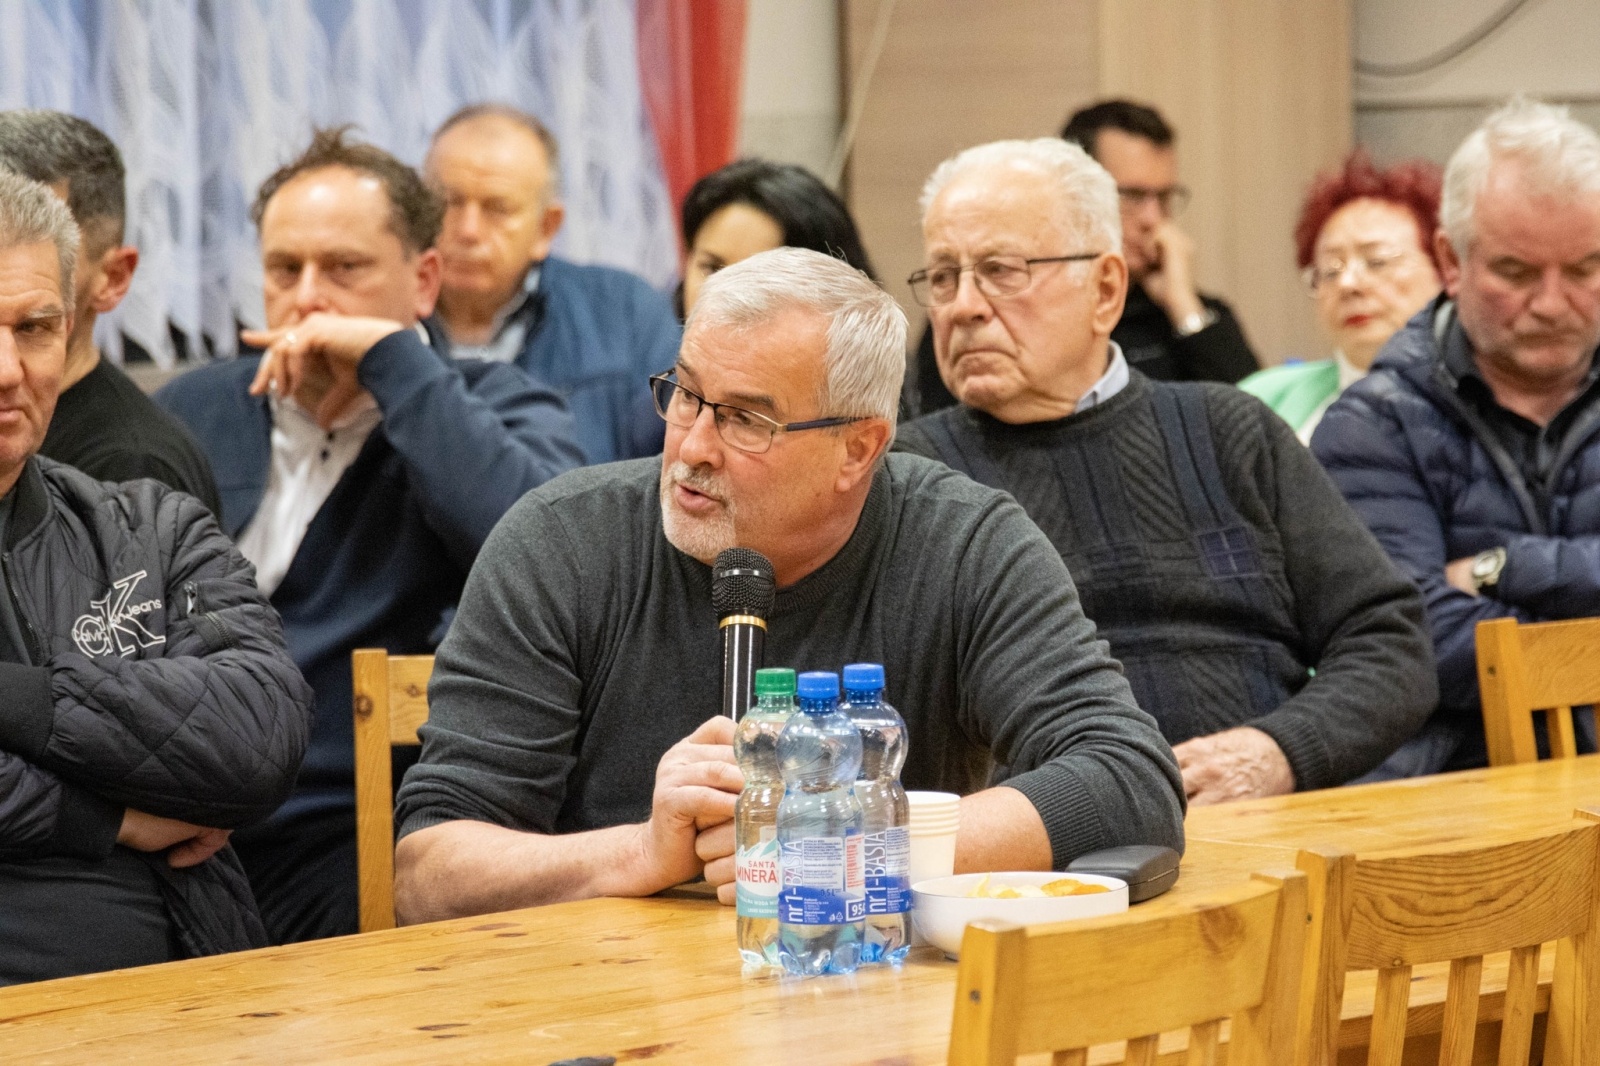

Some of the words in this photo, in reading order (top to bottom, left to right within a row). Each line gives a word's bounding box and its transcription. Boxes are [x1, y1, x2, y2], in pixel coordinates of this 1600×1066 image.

[72, 627, 107, 642] Calvin
[125, 599, 162, 617] Jeans
[748, 860, 776, 869] SANTA
